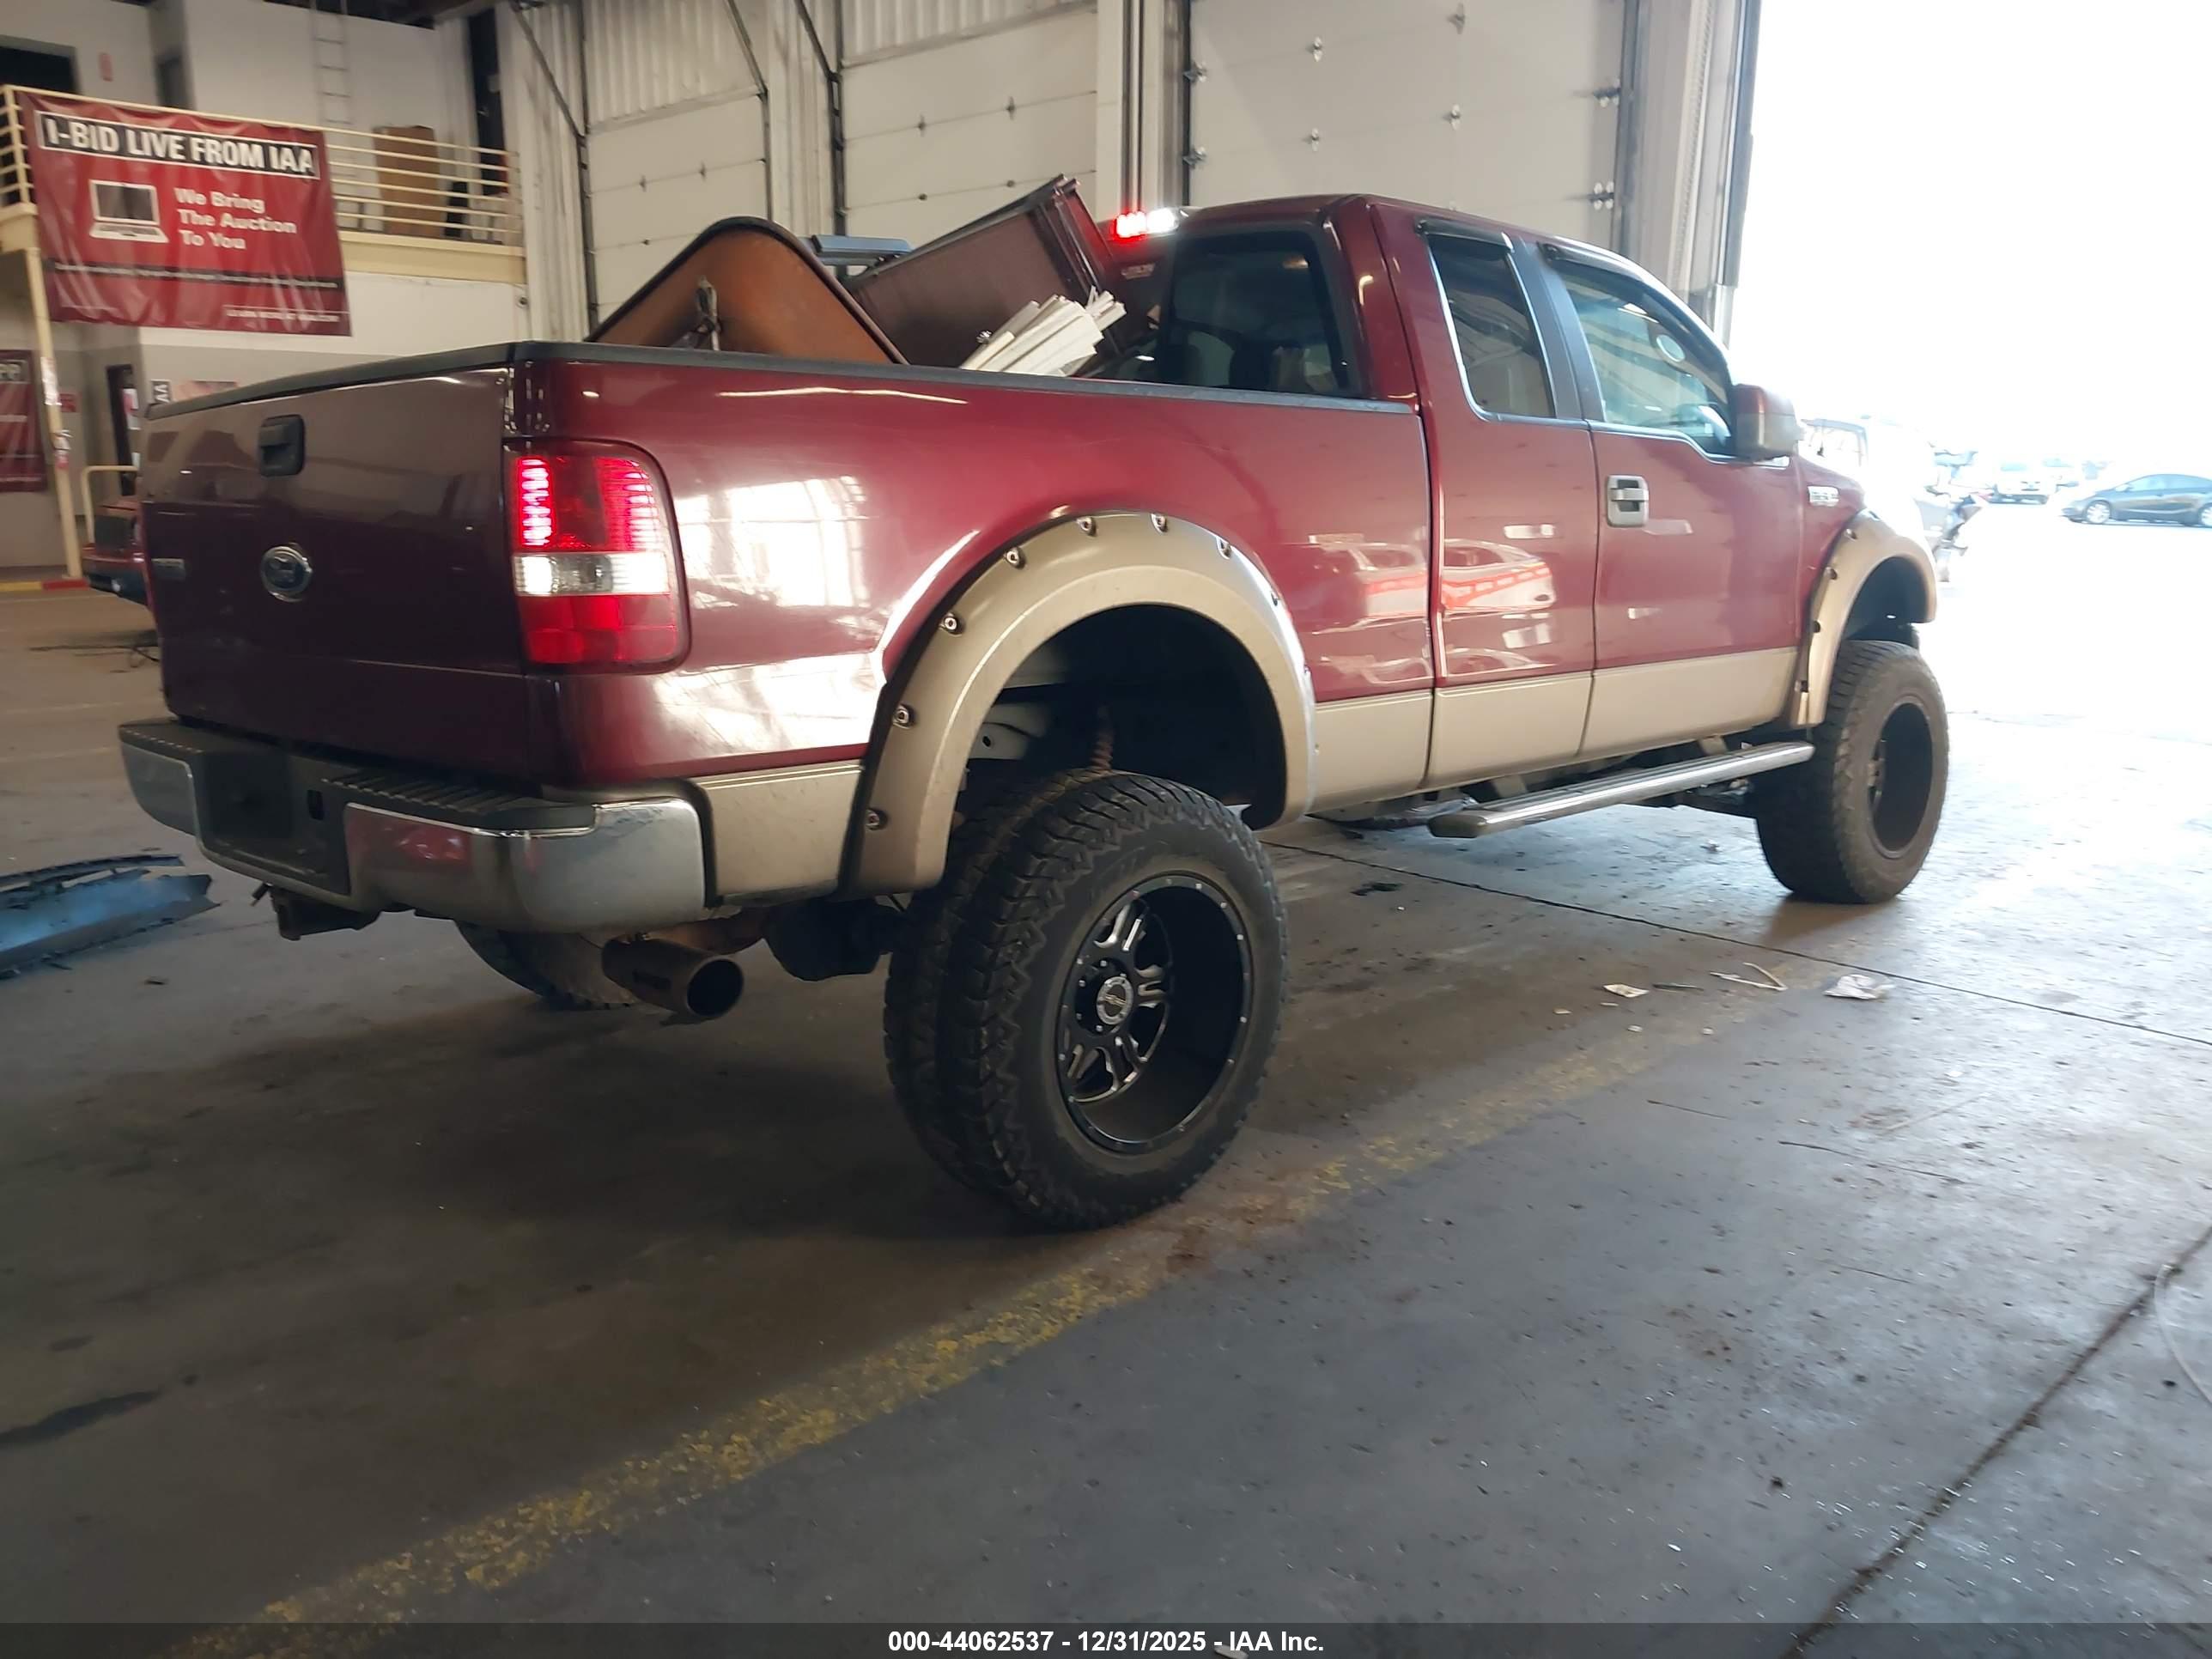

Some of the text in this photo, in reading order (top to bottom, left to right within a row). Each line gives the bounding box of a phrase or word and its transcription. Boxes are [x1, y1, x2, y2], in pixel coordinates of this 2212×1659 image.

[46, 118, 314, 173] I-BID LIVE FROM IAA
[174, 187, 265, 214] We Bring
[178, 209, 296, 234] The Auction
[180, 229, 246, 250] To You
